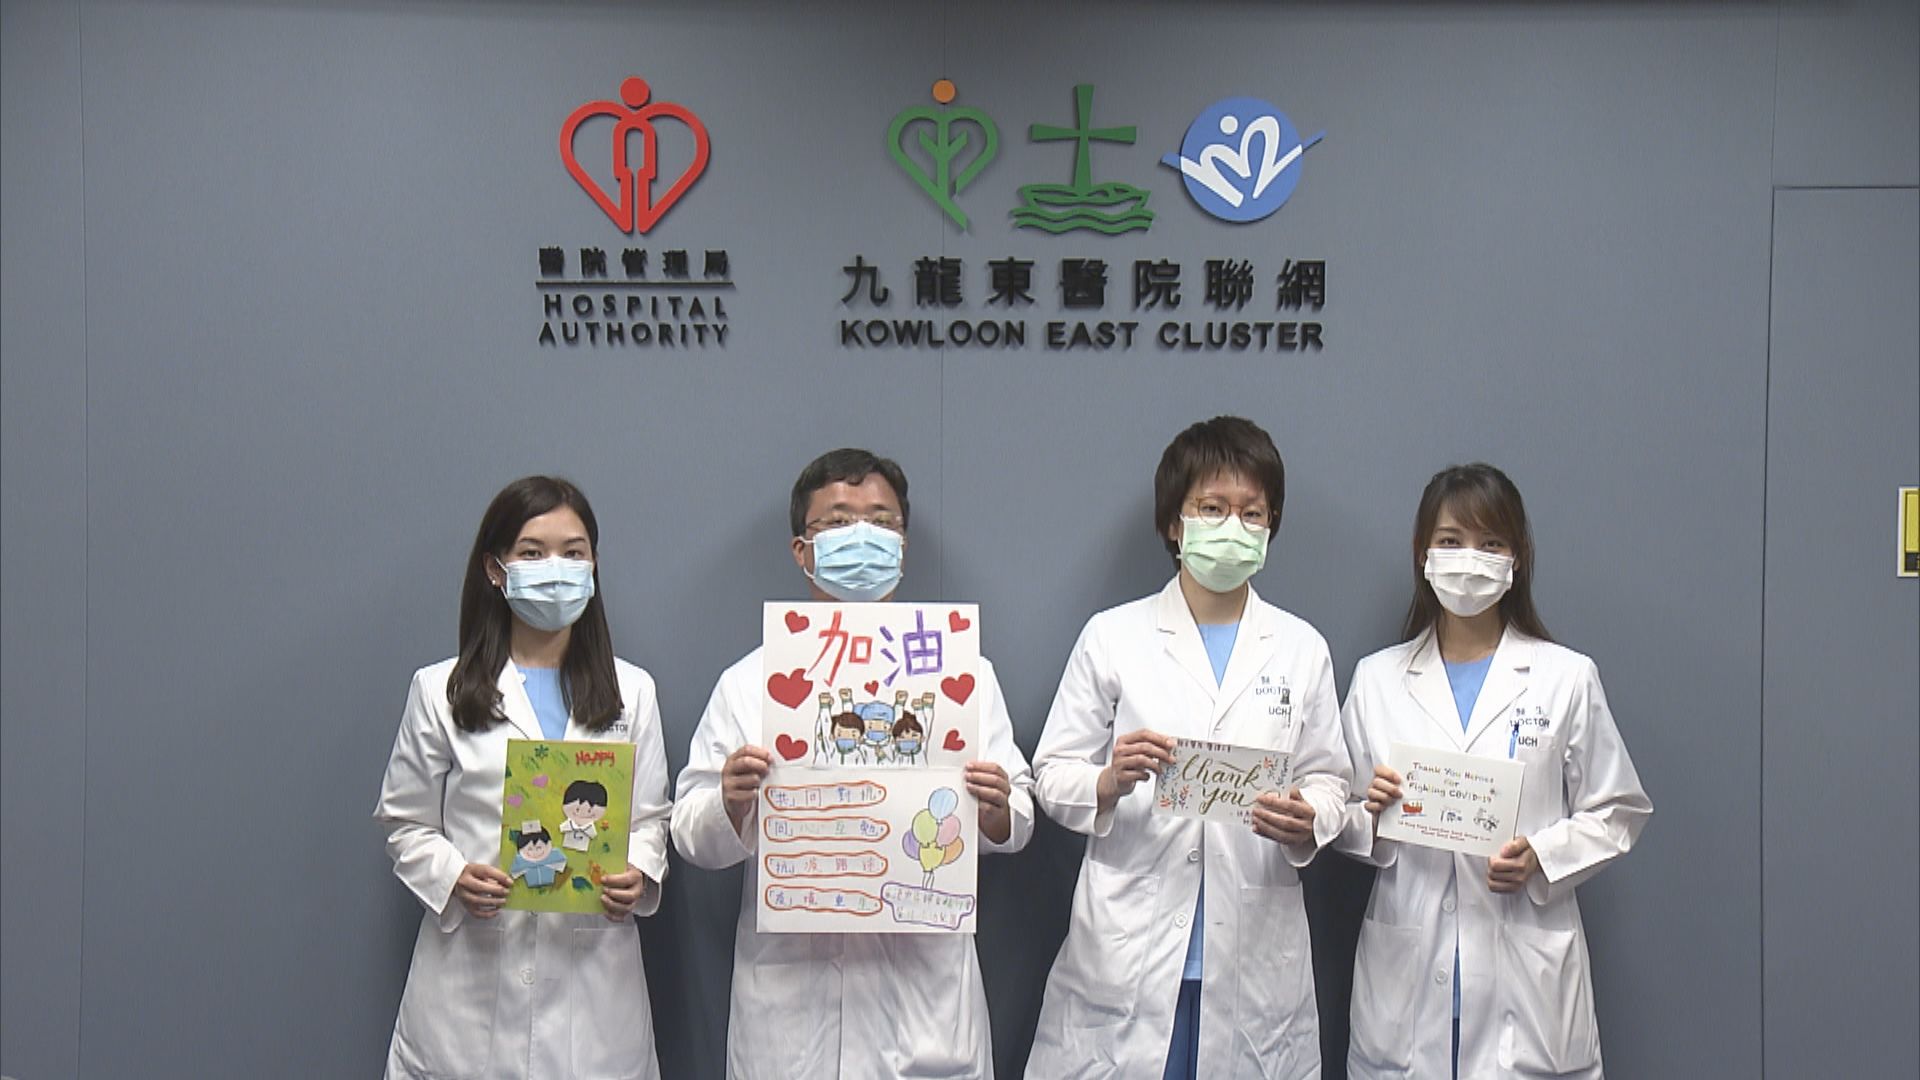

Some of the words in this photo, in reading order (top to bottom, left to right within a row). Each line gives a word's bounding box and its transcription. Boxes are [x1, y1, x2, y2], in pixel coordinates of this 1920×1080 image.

[539, 246, 729, 276] 醫院管理局
[841, 256, 1327, 309] 九龍東醫院聯網
[543, 293, 727, 318] HOSPITAL
[539, 321, 728, 346] AUTHORITY
[841, 320, 1025, 348] KOWLOON
[1047, 321, 1139, 349] EAST
[1158, 322, 1325, 351] CLUSTER
[806, 610, 943, 687] 加油
[1268, 705, 1288, 717] UCH
[1518, 735, 1538, 748] UCH
[575, 750, 616, 767] Happy
[1412, 762, 1441, 773] Thank
[1198, 784, 1257, 815] you
[1449, 789, 1492, 803] COVID-19
